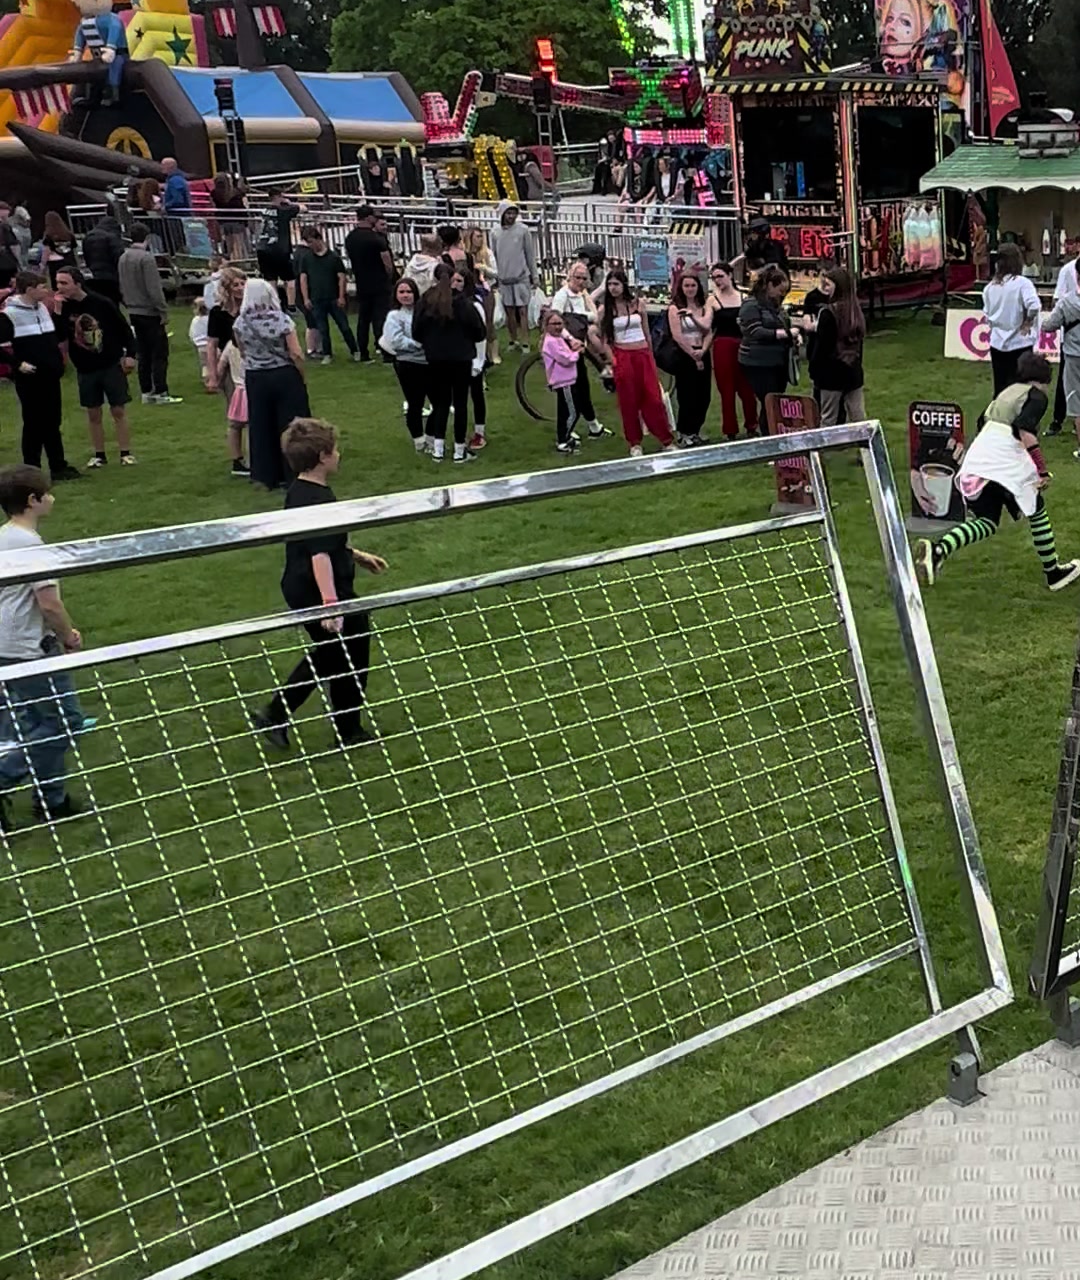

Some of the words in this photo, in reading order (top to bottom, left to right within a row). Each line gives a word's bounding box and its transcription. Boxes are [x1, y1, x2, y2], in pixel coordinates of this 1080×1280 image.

[733, 37, 796, 60] PUNK
[779, 397, 804, 419] Hot
[912, 410, 961, 428] COFFEE
